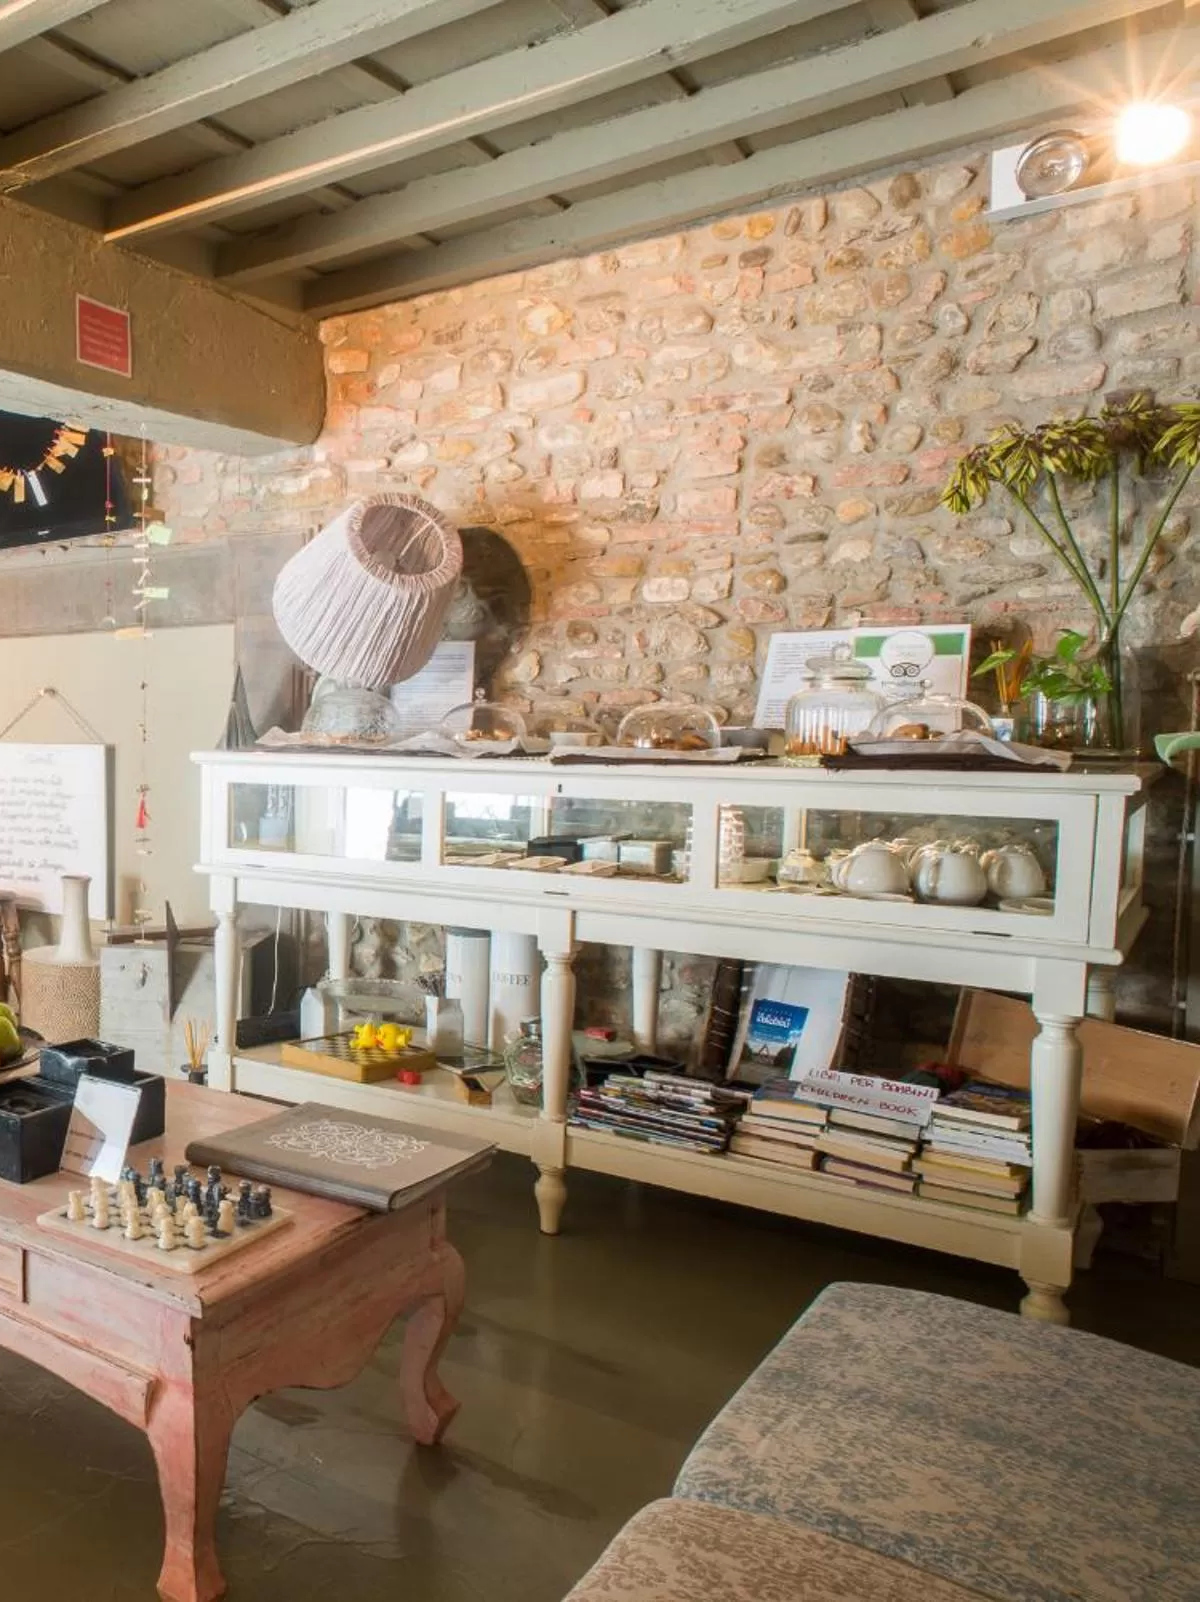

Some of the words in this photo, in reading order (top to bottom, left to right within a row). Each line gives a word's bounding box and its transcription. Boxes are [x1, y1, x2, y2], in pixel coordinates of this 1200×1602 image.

[850, 1076, 874, 1089] PER
[881, 1081, 934, 1099] BAMBINI
[879, 1102, 918, 1117] BOOK
